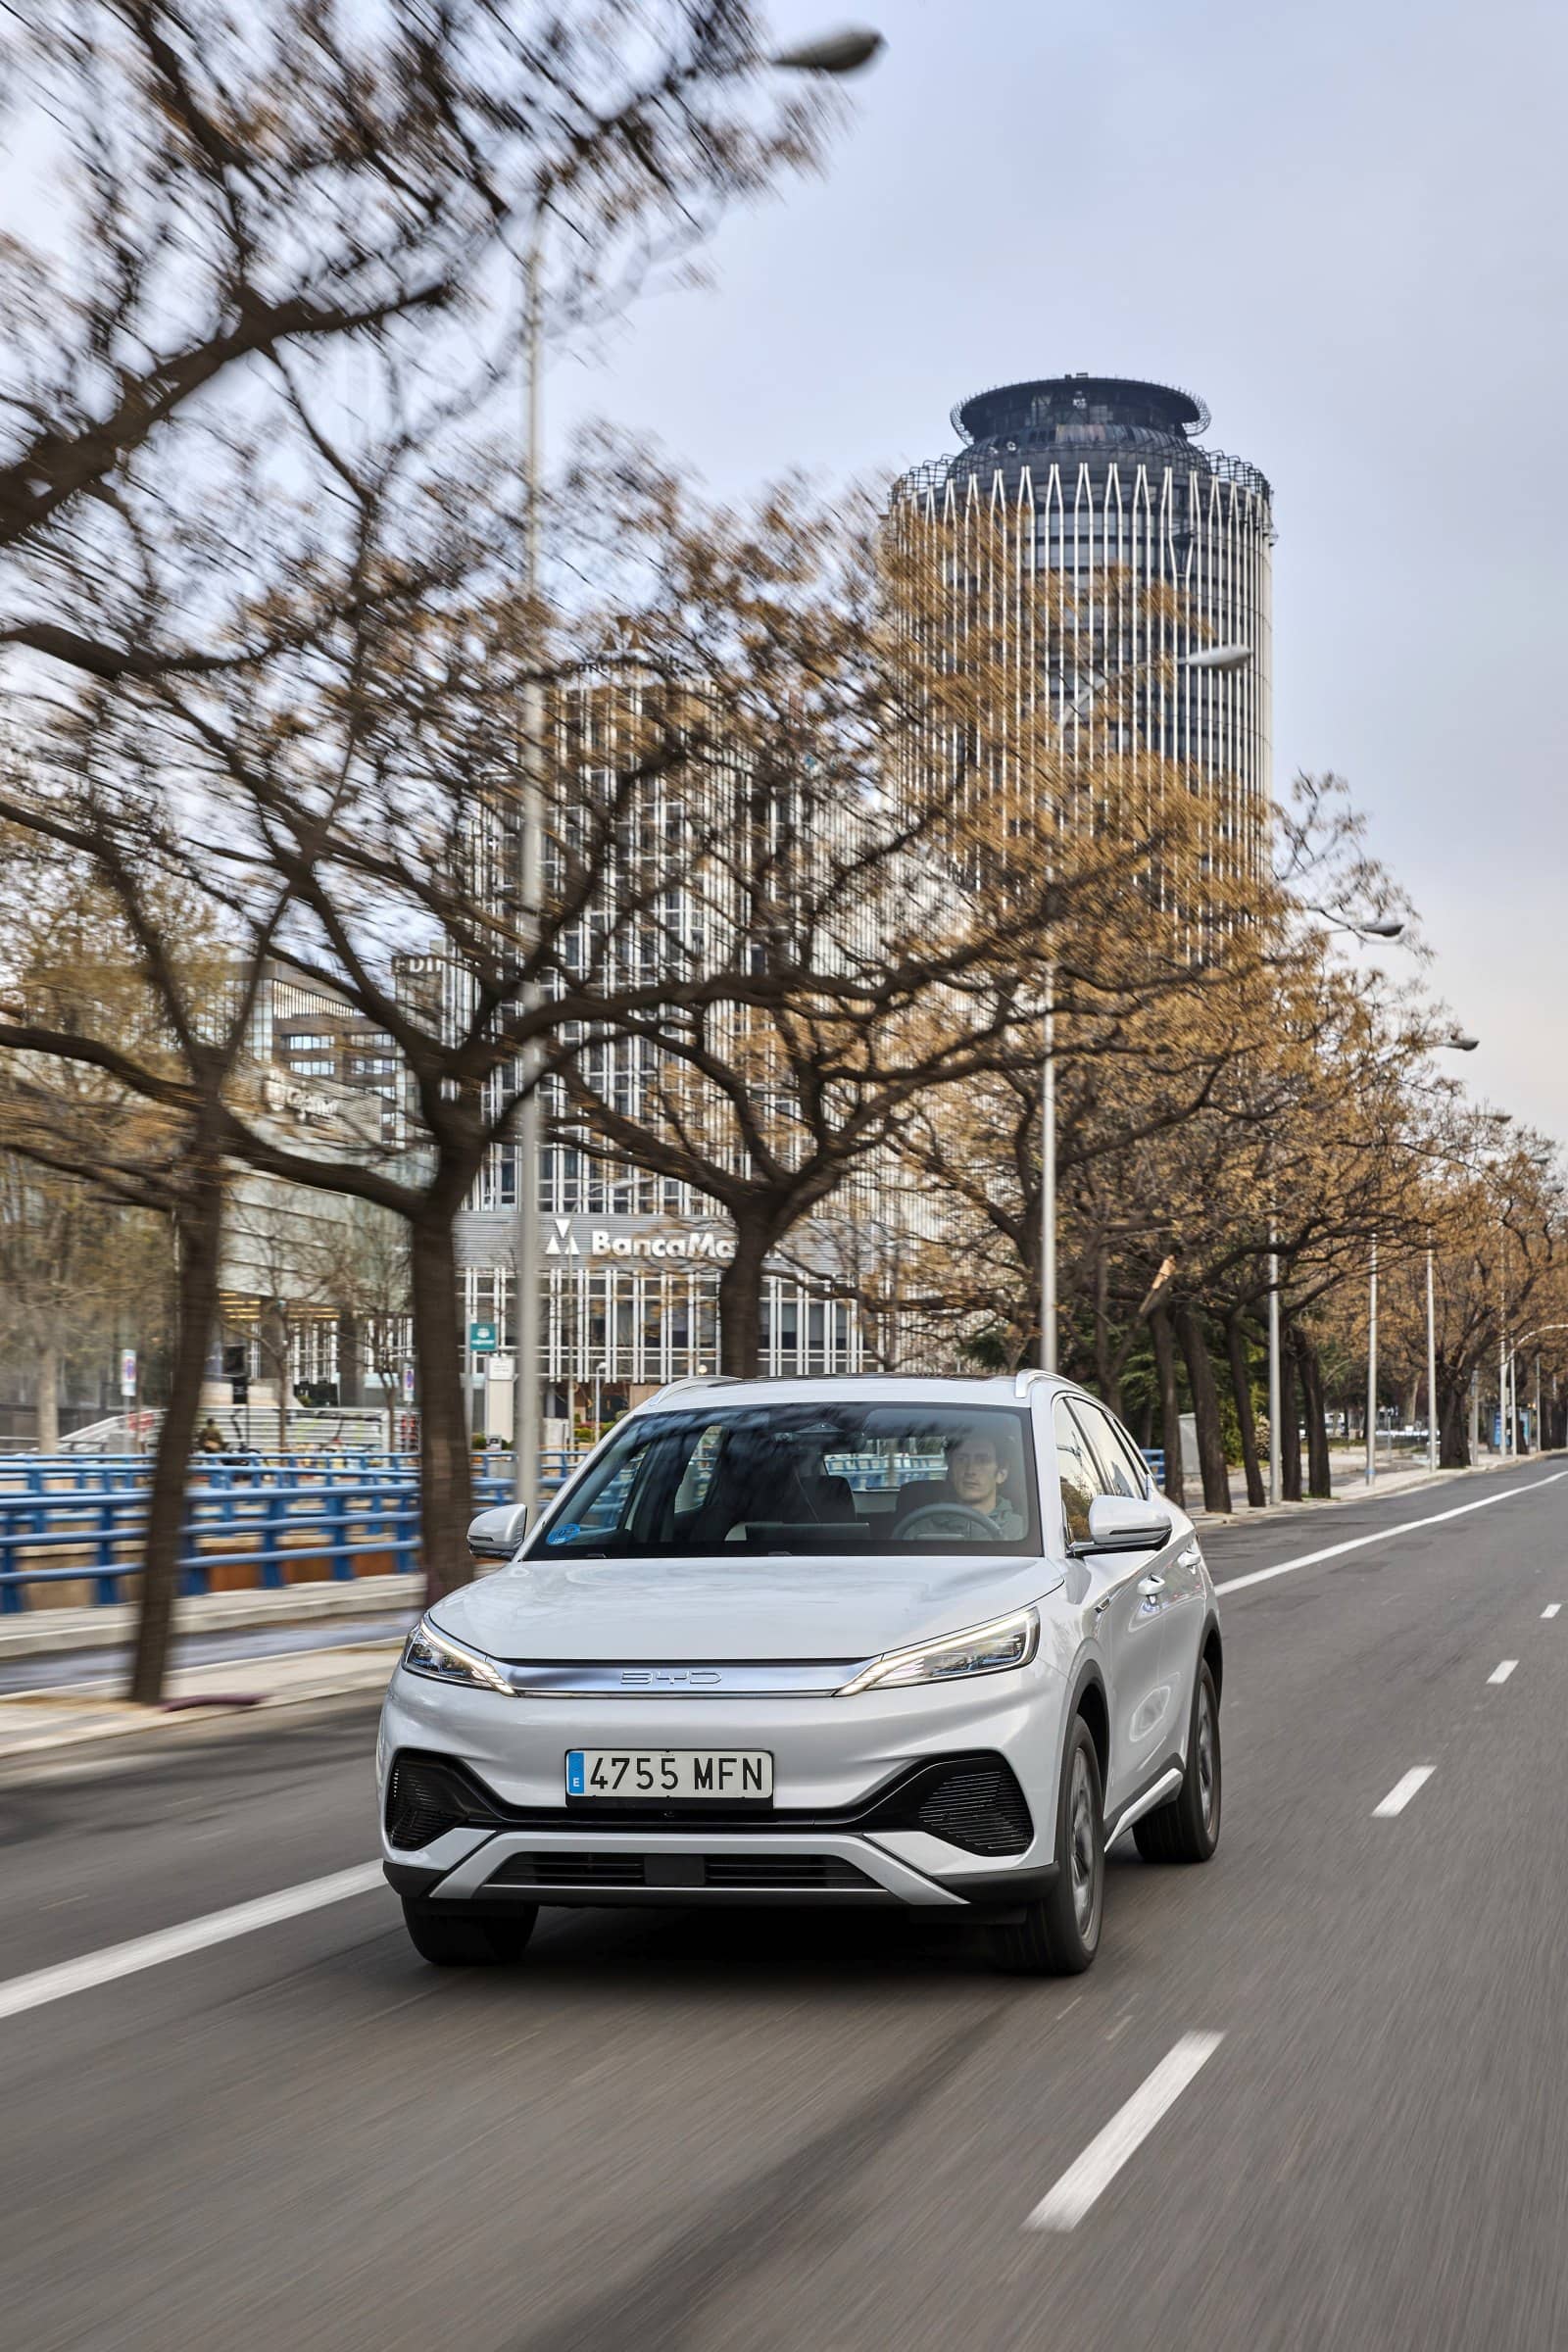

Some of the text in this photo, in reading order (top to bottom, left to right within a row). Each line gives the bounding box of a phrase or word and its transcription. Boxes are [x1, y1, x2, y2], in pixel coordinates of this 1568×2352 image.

[620, 1670, 722, 1685] BYD
[573, 1757, 762, 1790] E 4755 MFN
